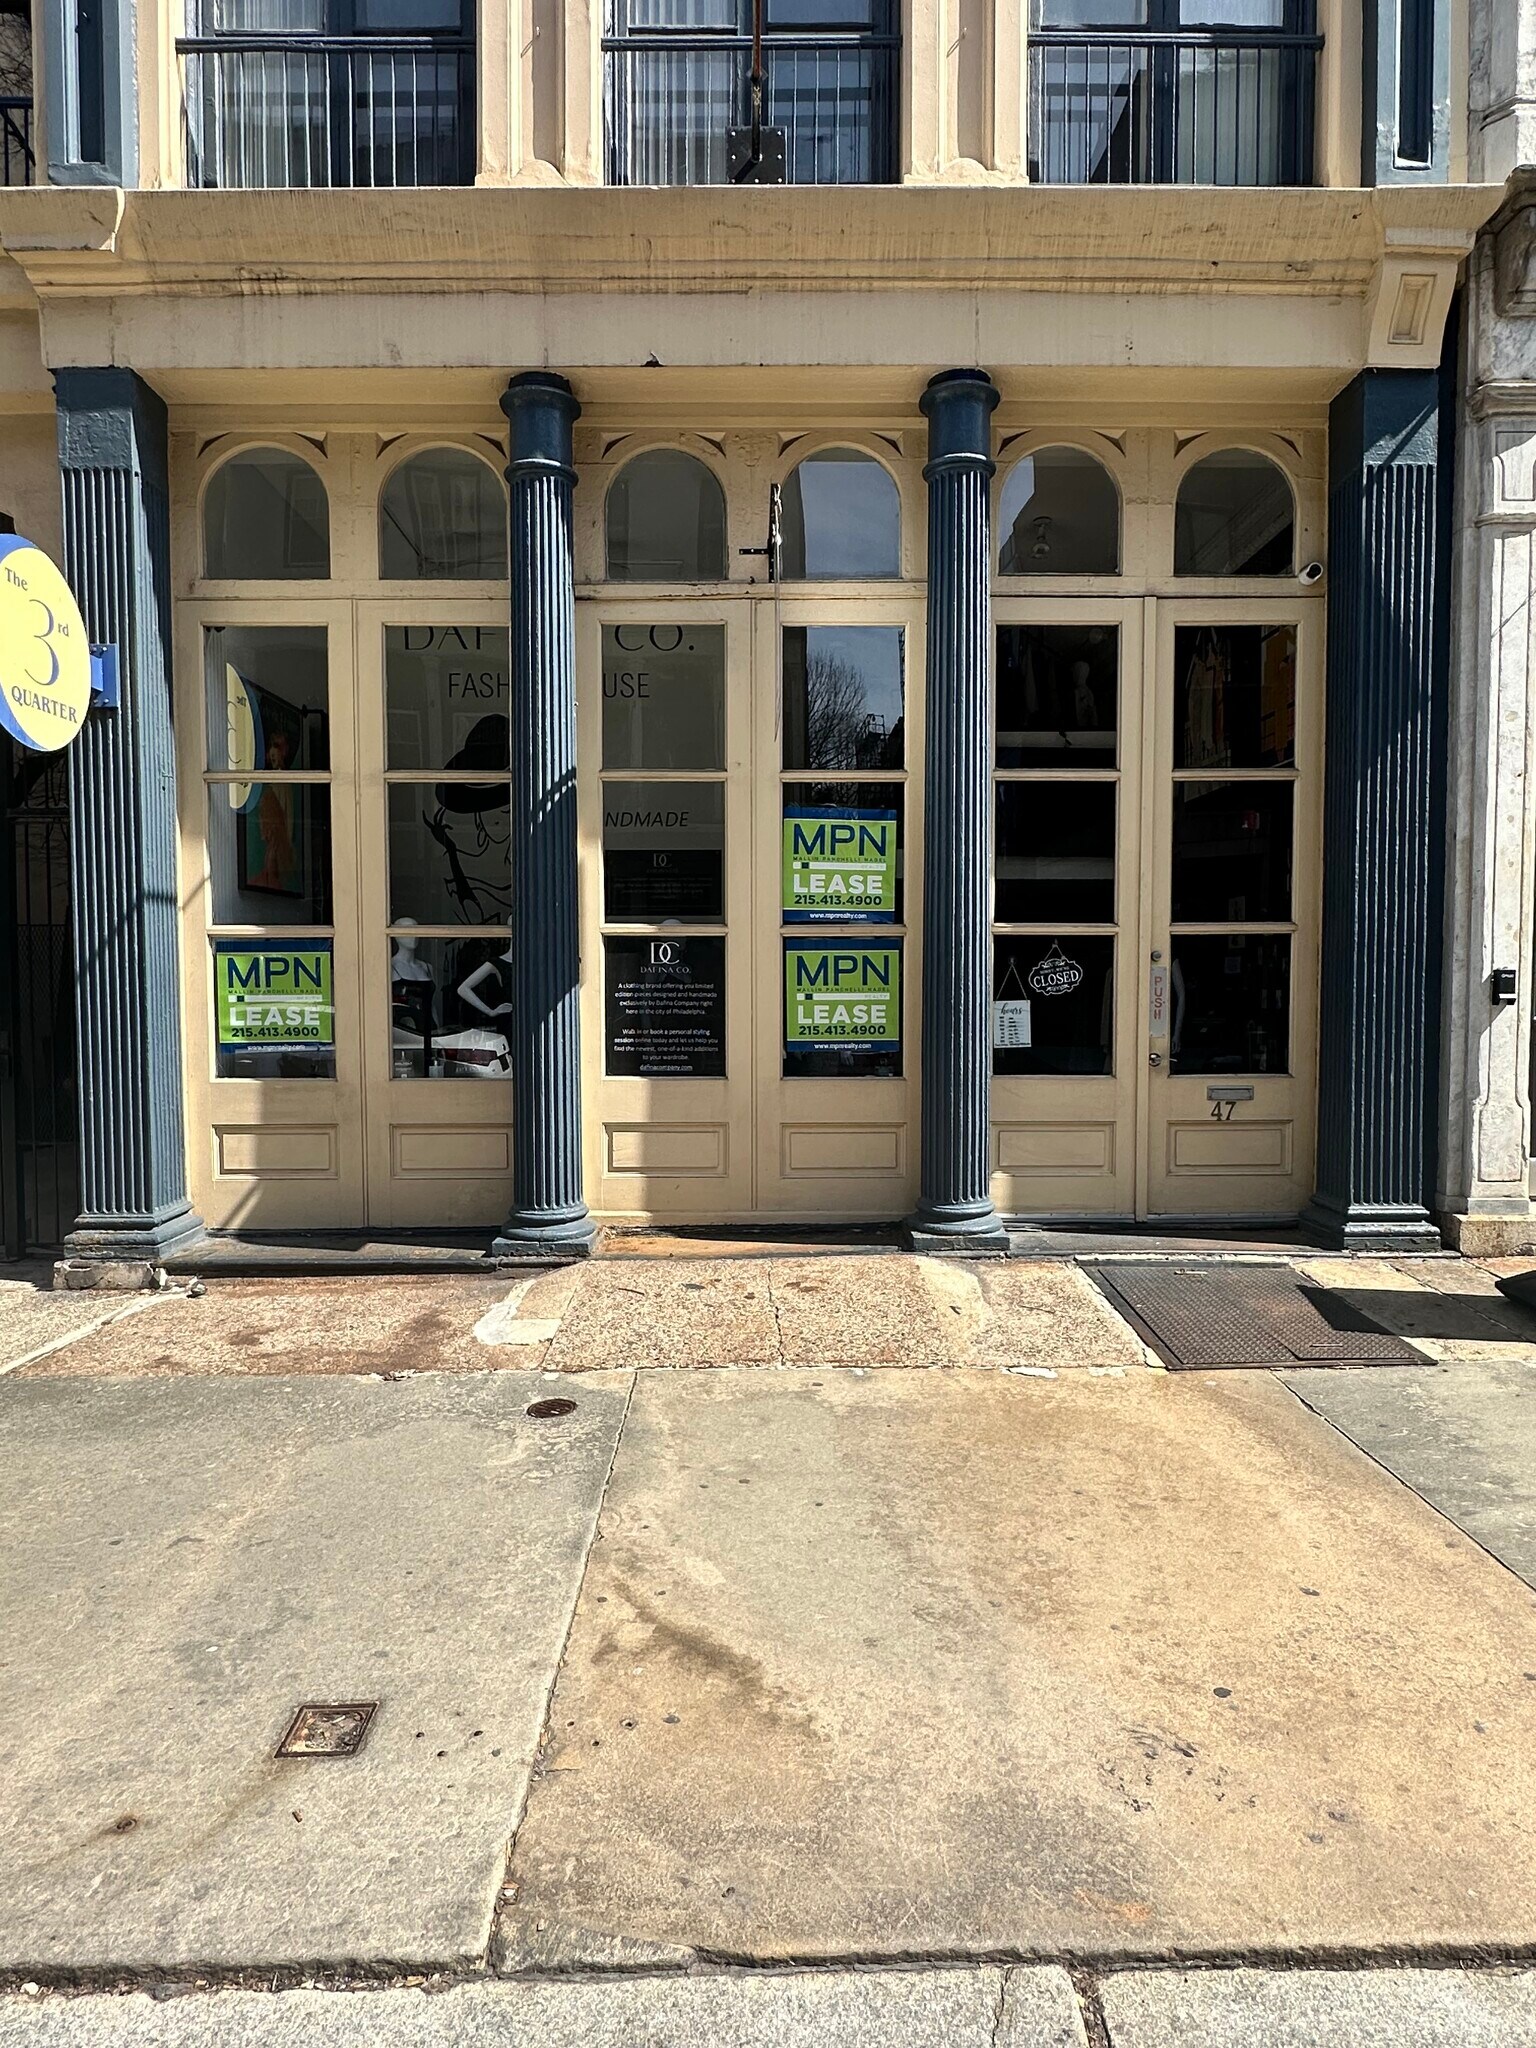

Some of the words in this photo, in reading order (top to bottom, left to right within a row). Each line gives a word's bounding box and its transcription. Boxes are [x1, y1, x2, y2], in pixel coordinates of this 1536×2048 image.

[5, 567, 28, 591] The
[404, 626, 496, 650] DAF
[615, 625, 694, 651] CO.
[448, 672, 509, 698] FASH
[602, 672, 650, 698] USE
[11, 685, 78, 724] QUARTER
[605, 811, 690, 827] NDMADE
[793, 823, 886, 856] MPN
[793, 874, 883, 894] LEASE
[794, 895, 882, 905] 215.413.4900
[651, 942, 680, 964] DC
[227, 957, 322, 988] MPN
[797, 955, 889, 986] MPN
[1033, 970, 1079, 987] CLOSED
[1154, 976, 1163, 1020] PUSH
[230, 1006, 320, 1026] LEASE
[798, 1005, 886, 1024] LEASE
[1001, 1002, 1022, 1015] hours
[231, 1027, 319, 1037] 215.413.4900
[798, 1025, 886, 1035] 215.413.4900
[1210, 1101, 1237, 1121] 47
